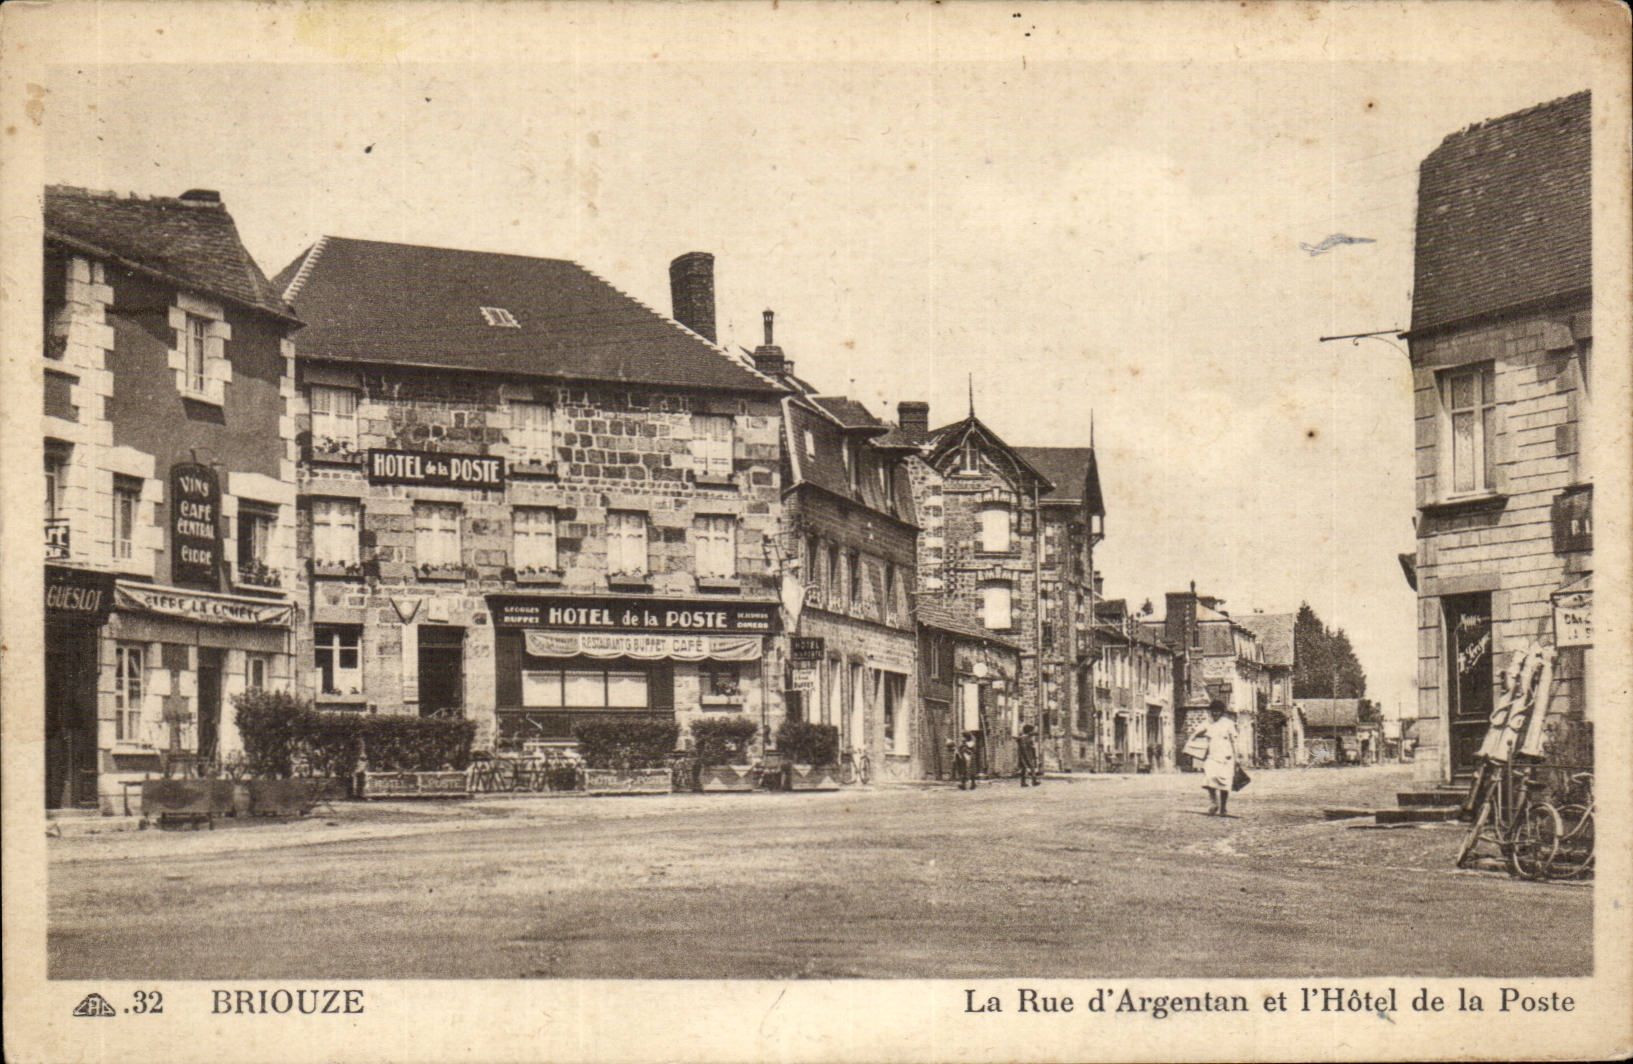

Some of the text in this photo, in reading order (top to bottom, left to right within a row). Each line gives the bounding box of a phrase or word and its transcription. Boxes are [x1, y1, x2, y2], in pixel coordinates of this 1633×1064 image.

[373, 453, 500, 484] HOTEL de la POSTE
[179, 475, 210, 498] VINS
[177, 518, 215, 539] CENTRAL
[181, 544, 213, 566] CIDRE
[548, 606, 728, 629] HOTEL de la POSTE
